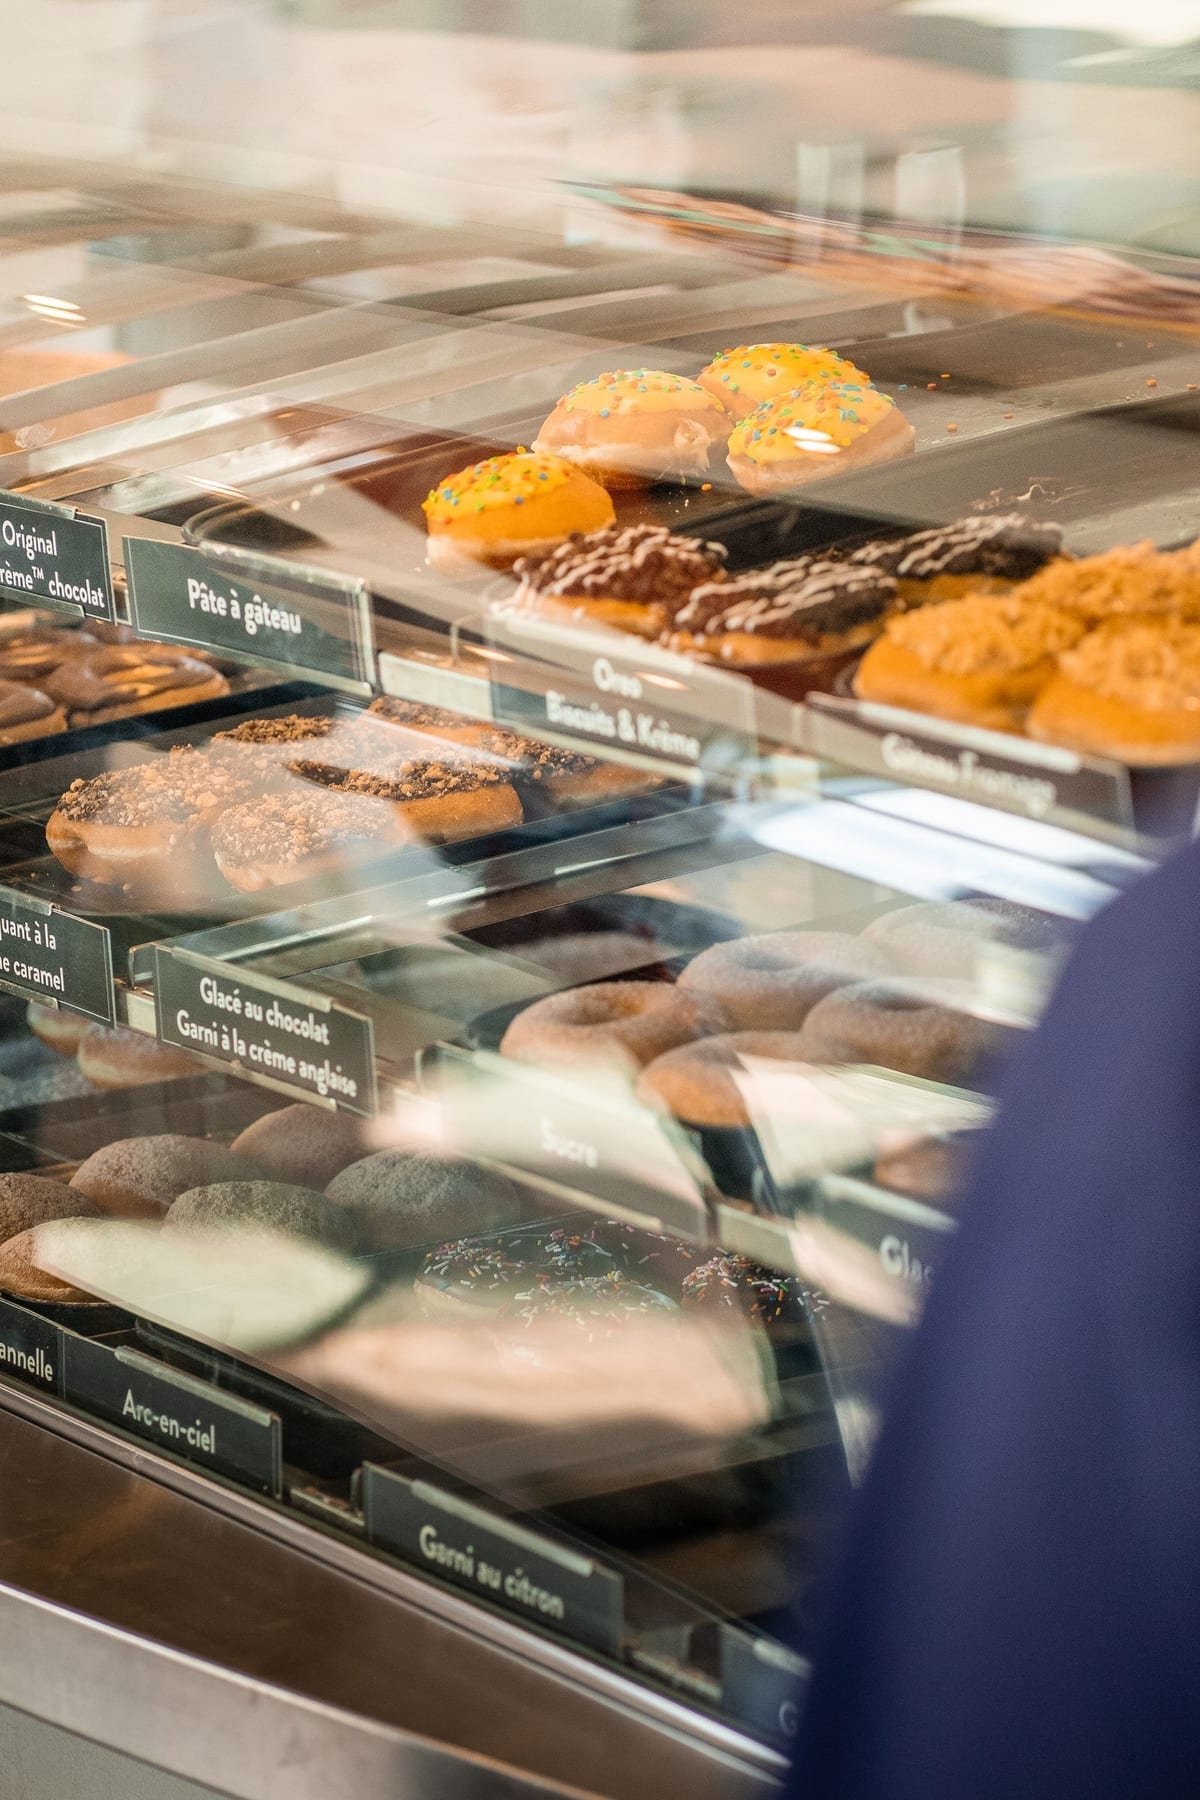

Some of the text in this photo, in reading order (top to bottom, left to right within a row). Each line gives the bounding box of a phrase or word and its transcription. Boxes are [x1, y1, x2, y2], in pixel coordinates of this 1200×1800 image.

[2, 520, 57, 560] Original
[48, 571, 105, 608] chocolat
[187, 578, 302, 635] Pâte à gâteau
[546, 690, 616, 737] Biscuits
[617, 708, 637, 742] &
[0, 918, 56, 950] uant à la
[13, 961, 65, 992] caramel
[200, 977, 330, 1046] Glacé au chocolat
[176, 1009, 357, 1098] Garni à la crème anglaise
[122, 1388, 216, 1454] Arc-en-ciel
[419, 1525, 564, 1619] Garni au citron
